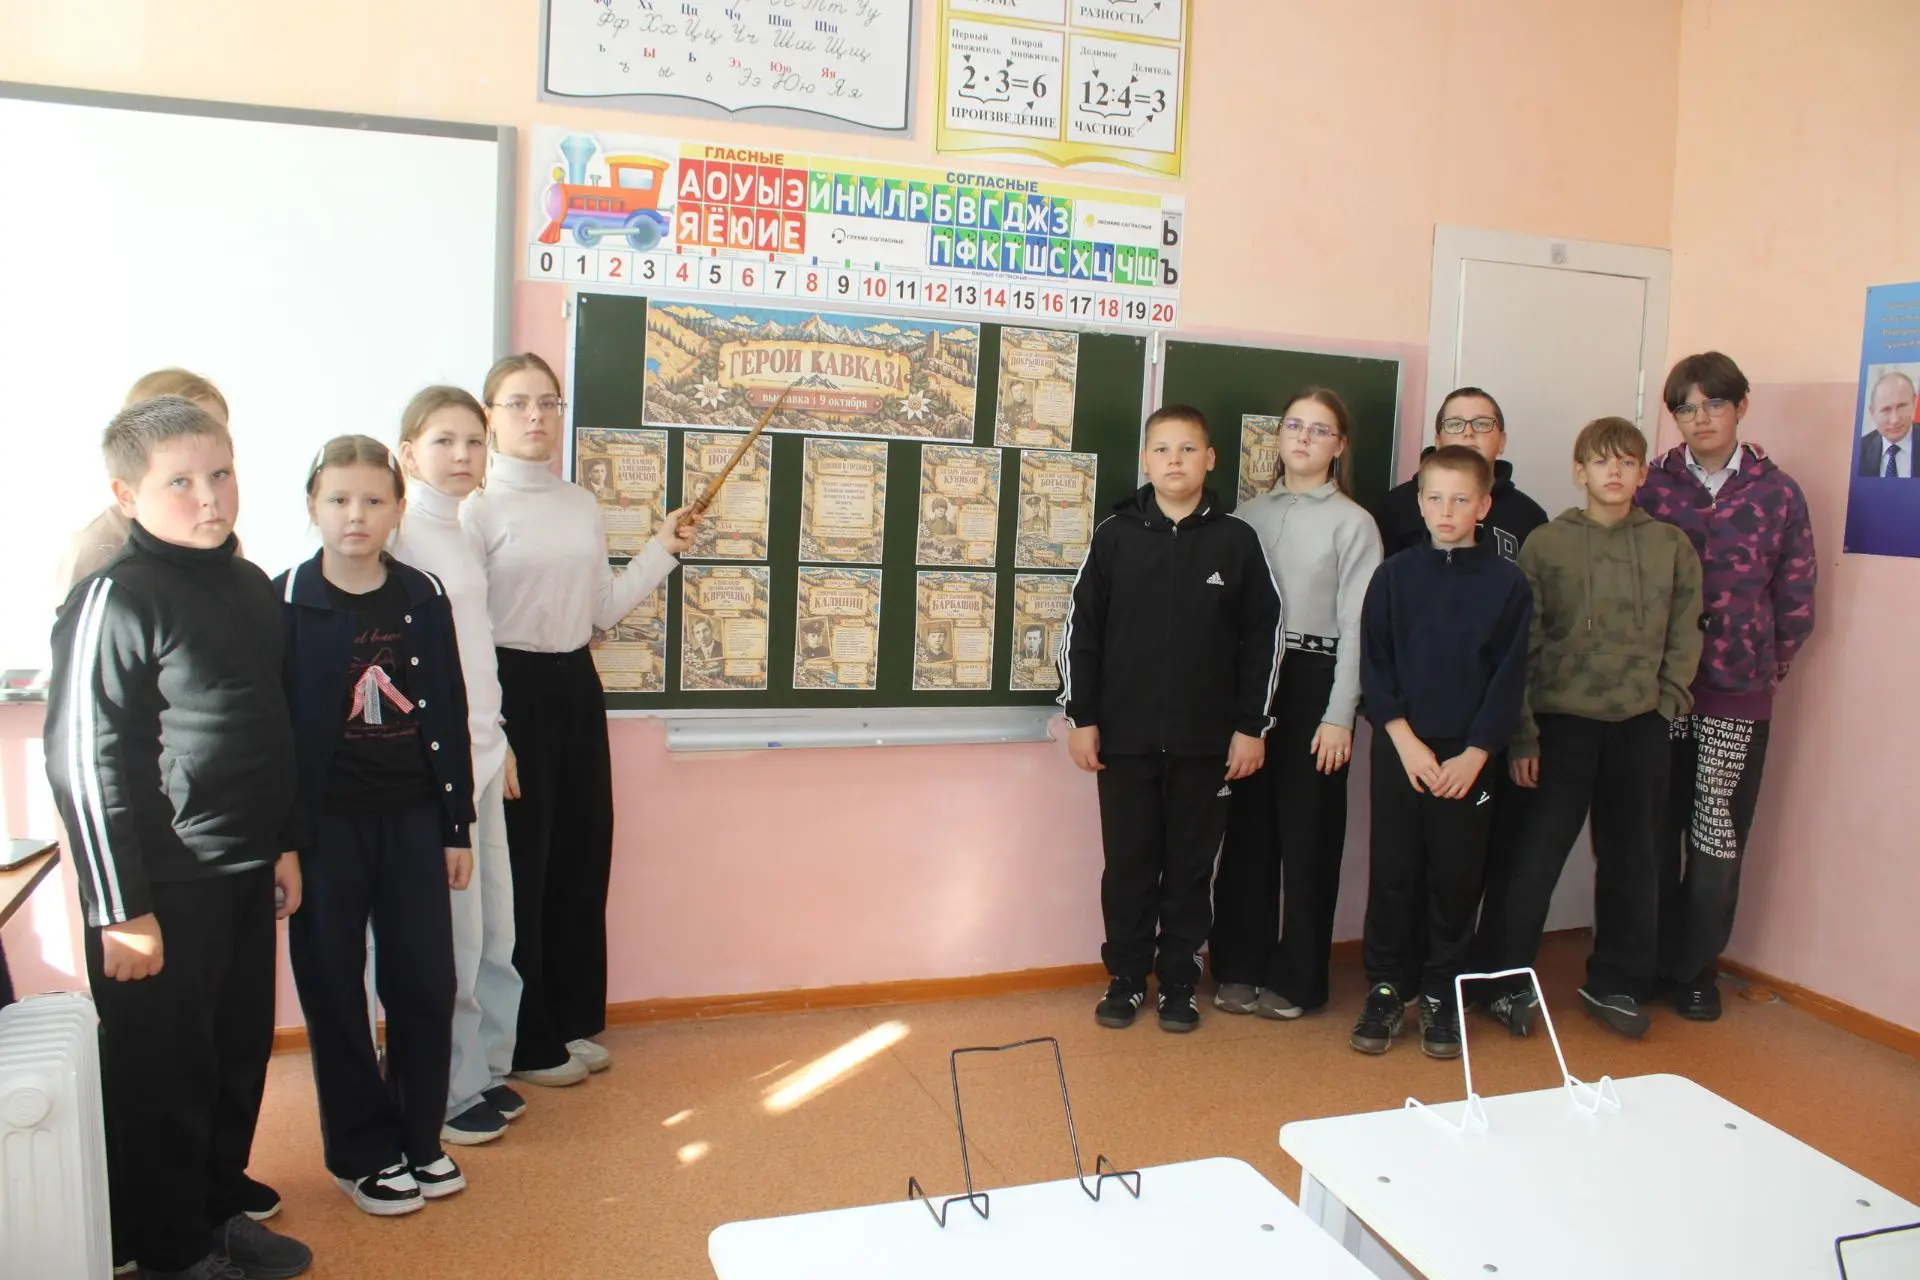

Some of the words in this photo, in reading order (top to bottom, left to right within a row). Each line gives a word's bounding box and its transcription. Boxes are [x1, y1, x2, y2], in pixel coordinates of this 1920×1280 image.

[1080, 6, 1144, 24] РАЗНОСТЬ
[952, 28, 989, 41] Первый
[951, 42, 1002, 55] множитель
[1011, 37, 1043, 49] Второй
[1010, 50, 1060, 63] множитель
[1079, 46, 1118, 59] Делимое
[1131, 62, 1172, 76] Делитель
[951, 107, 1057, 129] ПРОИЗВЕДЕНИЕ
[1074, 120, 1135, 138] ЧАСТНОЕ
[704, 146, 785, 166] ГЛАСНЫЕ
[946, 171, 1039, 194] СОГЛАСНЫЕ
[1121, 221, 1152, 230] СОГЛАСНЫЕ
[540, 252, 553, 273] 0
[576, 255, 586, 275] 1
[609, 258, 622, 277] 2
[643, 260, 656, 280] 3
[676, 262, 689, 282] 4
[709, 265, 722, 284] 5
[742, 267, 754, 287] 6
[774, 270, 787, 290] 7
[806, 272, 818, 292] 8
[837, 274, 850, 295] 9
[863, 277, 887, 298] 10
[895, 280, 917, 301] 11
[924, 283, 947, 303] 12
[954, 285, 977, 306] 13
[984, 288, 1006, 308] 14
[1013, 290, 1036, 310] 15
[1042, 292, 1064, 313] 16
[1070, 295, 1092, 315] 17
[1098, 298, 1119, 318] 18
[1126, 300, 1146, 320] 19
[1152, 303, 1174, 323] 20
[730, 348, 803, 380] ГЕРОИ
[810, 350, 905, 392] КАВКАЗА
[762, 392, 810, 406] вытавка
[828, 397, 869, 409] октября
[932, 599, 980, 611] БАРБАШОВ
[1735, 724, 1746, 733] IN
[1716, 729, 1751, 743] TWIRLS
[1717, 748, 1747, 761] EVERY
[1697, 753, 1725, 767] OUCH
[1725, 761, 1745, 771] AND
[1724, 779, 1738, 788] US
[1701, 794, 1715, 805] US
